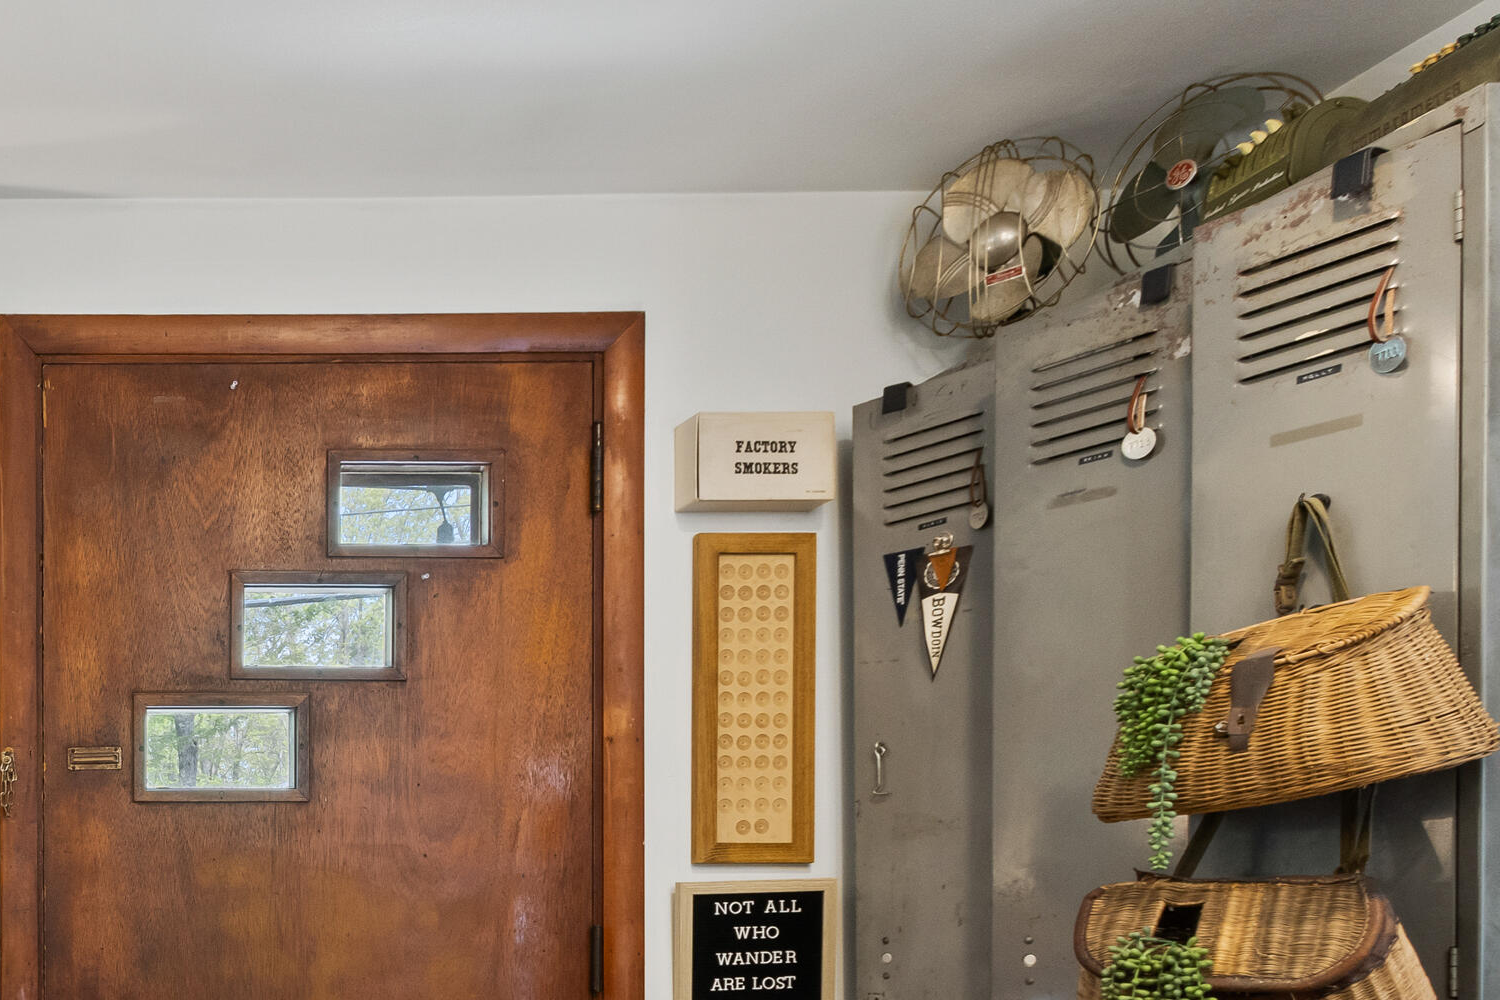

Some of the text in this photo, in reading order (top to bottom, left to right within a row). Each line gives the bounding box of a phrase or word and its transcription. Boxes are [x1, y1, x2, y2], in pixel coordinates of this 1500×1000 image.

[736, 441, 796, 453] FACTORY
[735, 462, 798, 474] SMOKERS
[897, 554, 906, 605] PENN STATE
[931, 596, 946, 658] BOWDOIN
[715, 900, 801, 915] NOT ALL
[734, 926, 779, 939] WHO
[716, 951, 796, 965] WANDER
[711, 976, 796, 991] ARE LOST
